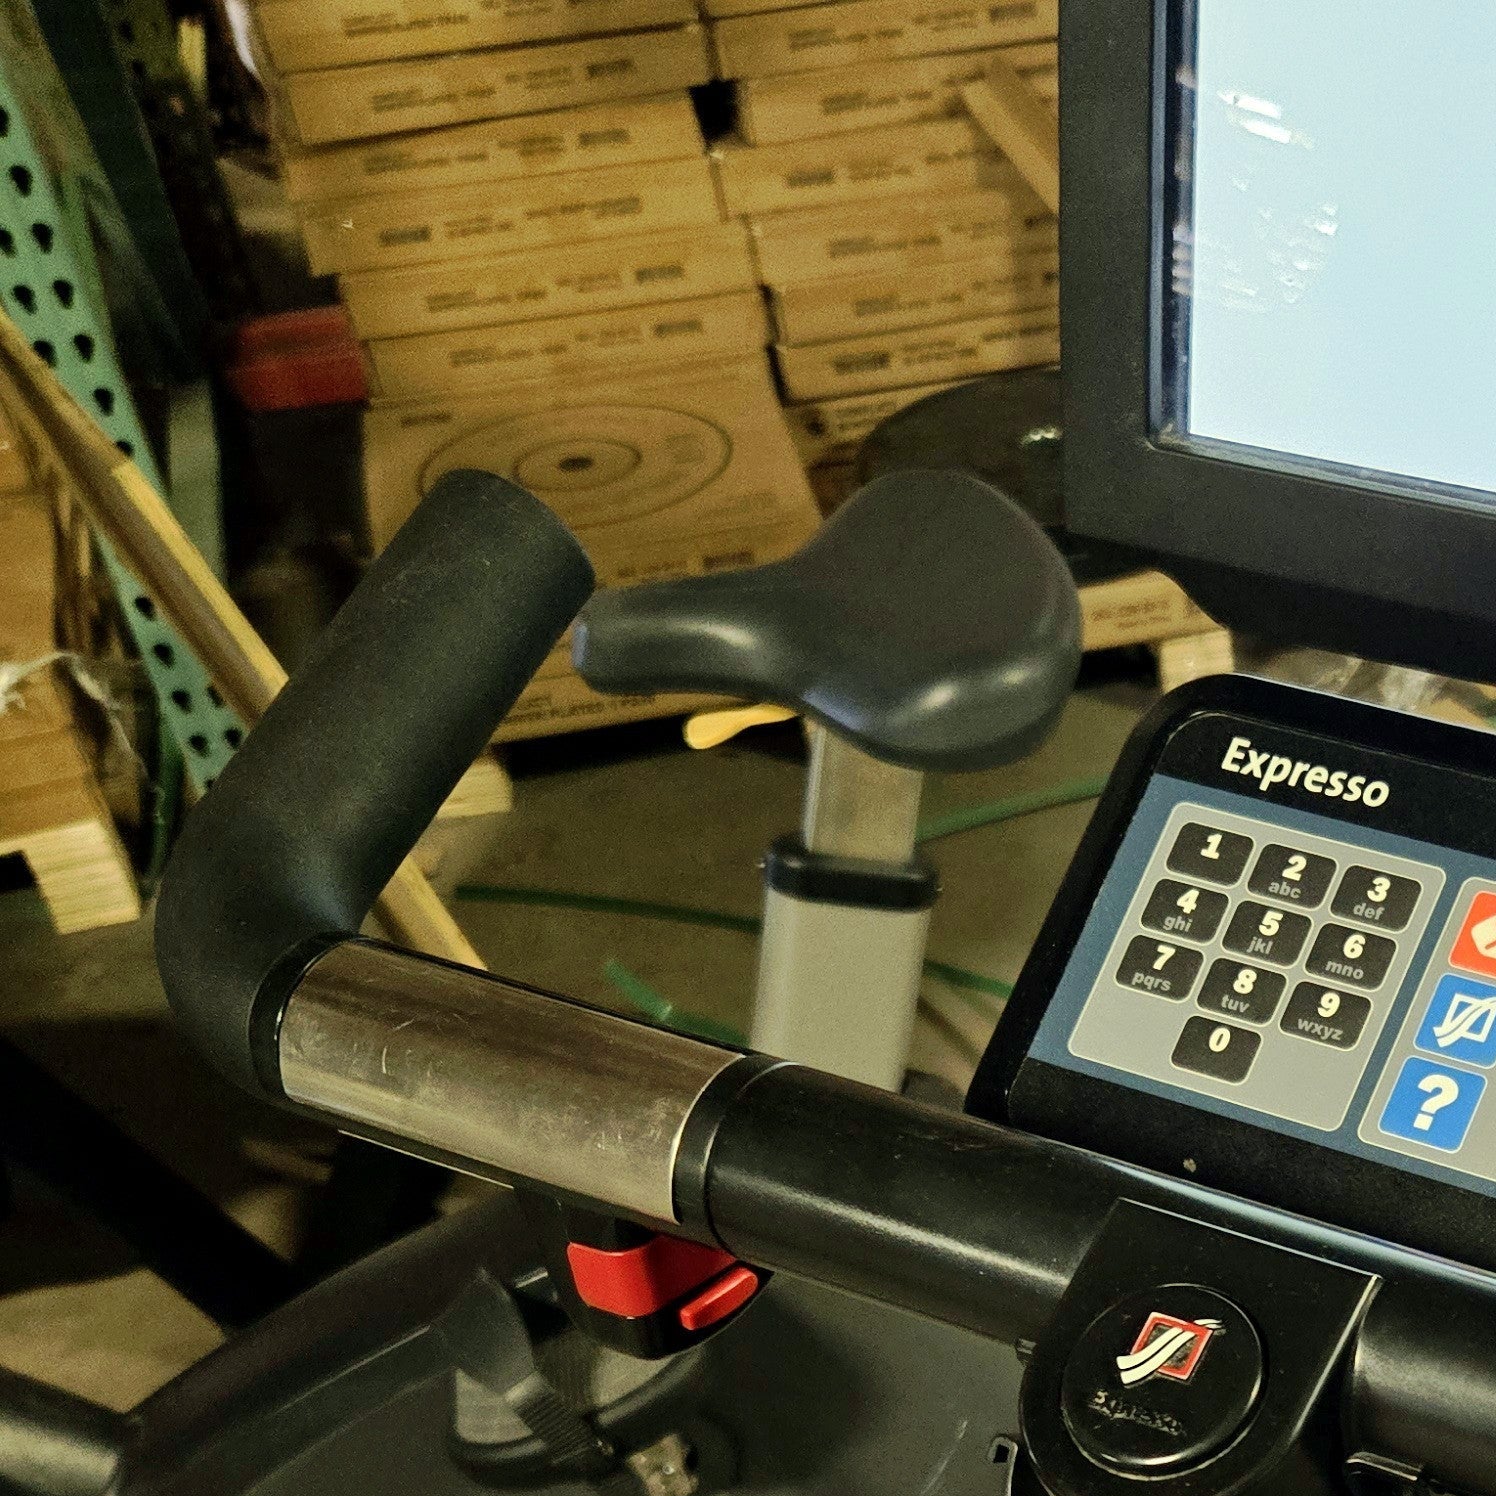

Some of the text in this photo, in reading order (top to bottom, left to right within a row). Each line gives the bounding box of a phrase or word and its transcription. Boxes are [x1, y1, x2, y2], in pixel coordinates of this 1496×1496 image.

[1220, 736, 1390, 808] Expresso
[1200, 833, 1223, 860] 1
[1281, 855, 1307, 881] 2
[1176, 889, 1200, 914] 4
[1268, 880, 1301, 899] abc
[1366, 876, 1391, 902] 3
[1162, 915, 1193, 932] ghi
[1258, 910, 1284, 936] 5
[1353, 902, 1385, 920] def
[1152, 944, 1176, 970] 7
[1246, 936, 1273, 954] jkl
[1343, 934, 1366, 959] 6
[1131, 971, 1172, 991] pqrs
[1233, 969, 1258, 994] 8
[1325, 960, 1364, 980] mno
[1221, 994, 1250, 1013] tuv
[1317, 991, 1341, 1018] 9
[1208, 1027, 1231, 1052] 0
[1297, 1018, 1344, 1041] wxyz
[1417, 1074, 1459, 1131] ?
